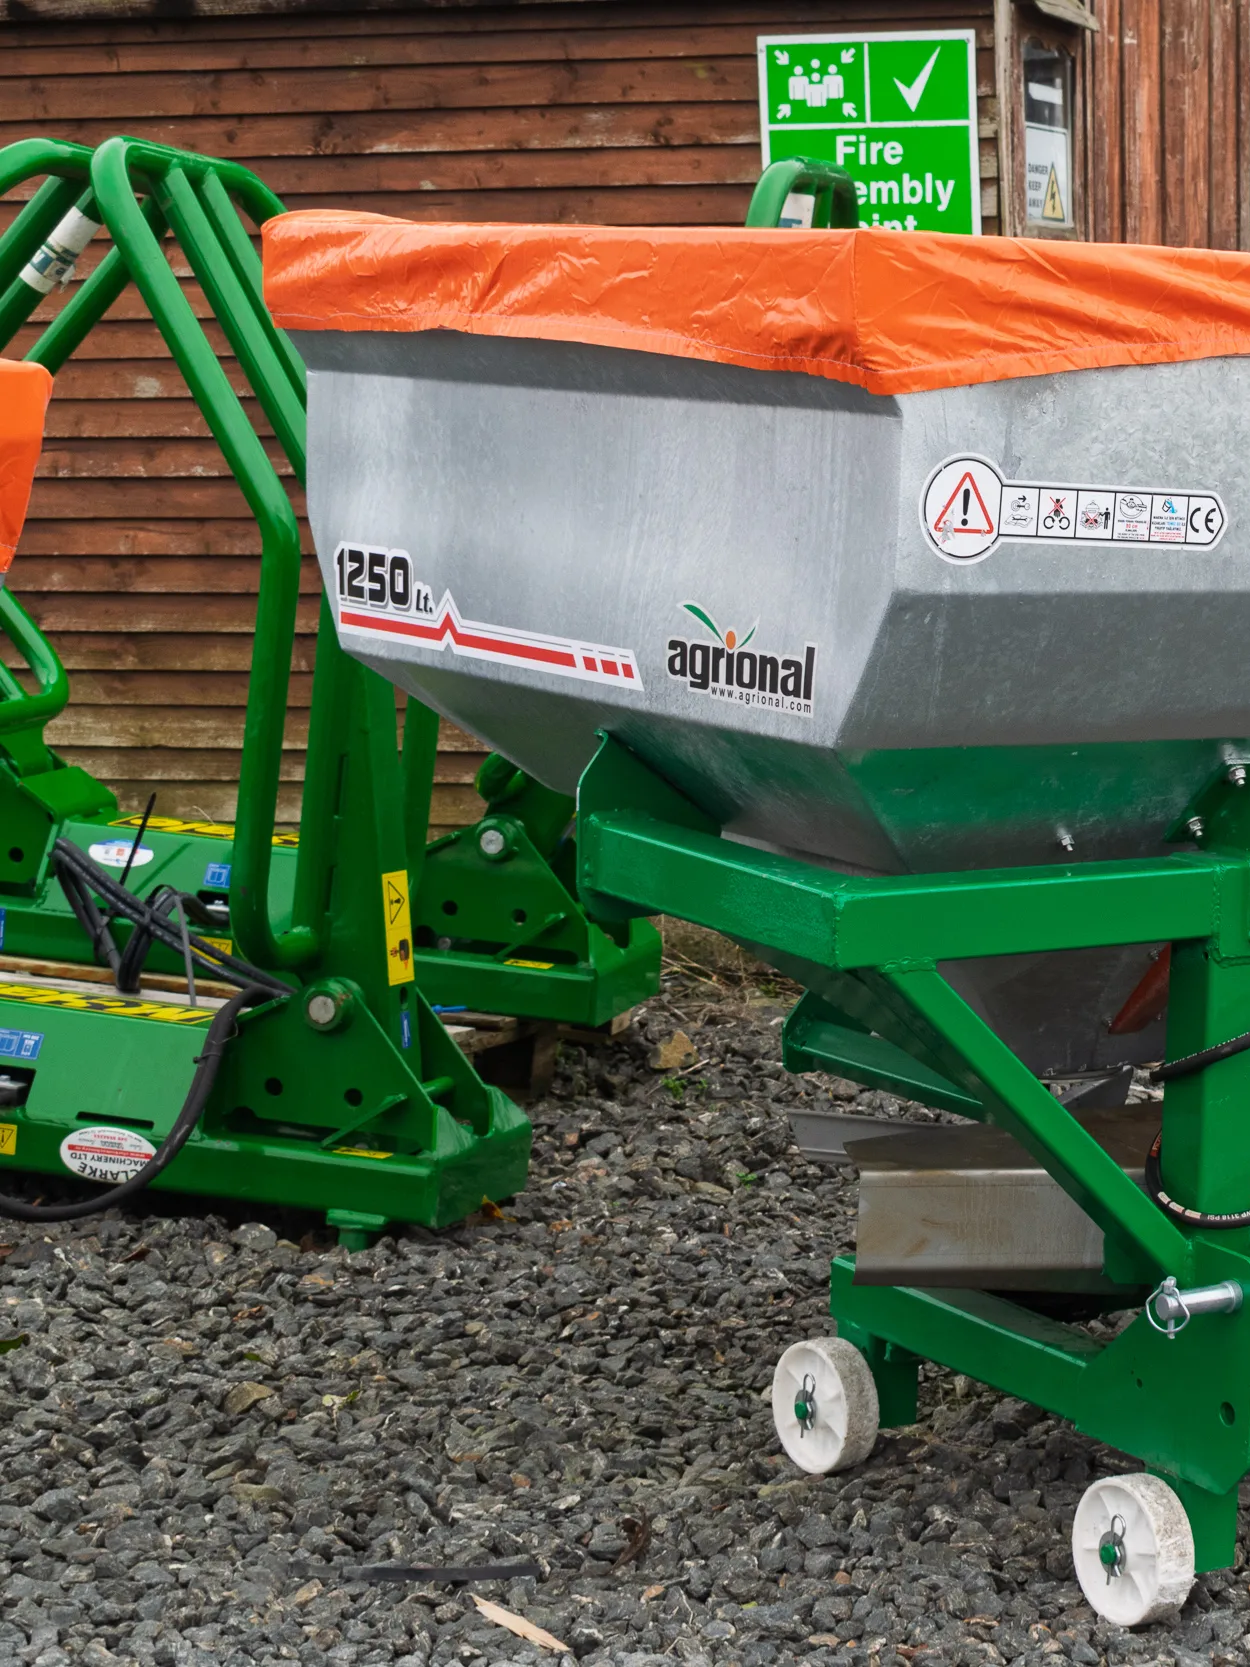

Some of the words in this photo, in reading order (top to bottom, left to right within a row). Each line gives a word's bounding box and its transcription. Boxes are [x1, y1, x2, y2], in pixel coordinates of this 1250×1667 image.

[836, 135, 904, 166] Fire
[856, 172, 955, 212] embly
[336, 549, 410, 606] 1250
[416, 589, 433, 614] Lt.
[667, 637, 816, 701] agrional
[711, 685, 812, 715] www.agrional.com
[70, 1152, 87, 1160] LTD
[90, 1154, 148, 1168] MACHINERY
[1207, 1213, 1220, 1221] PSI
